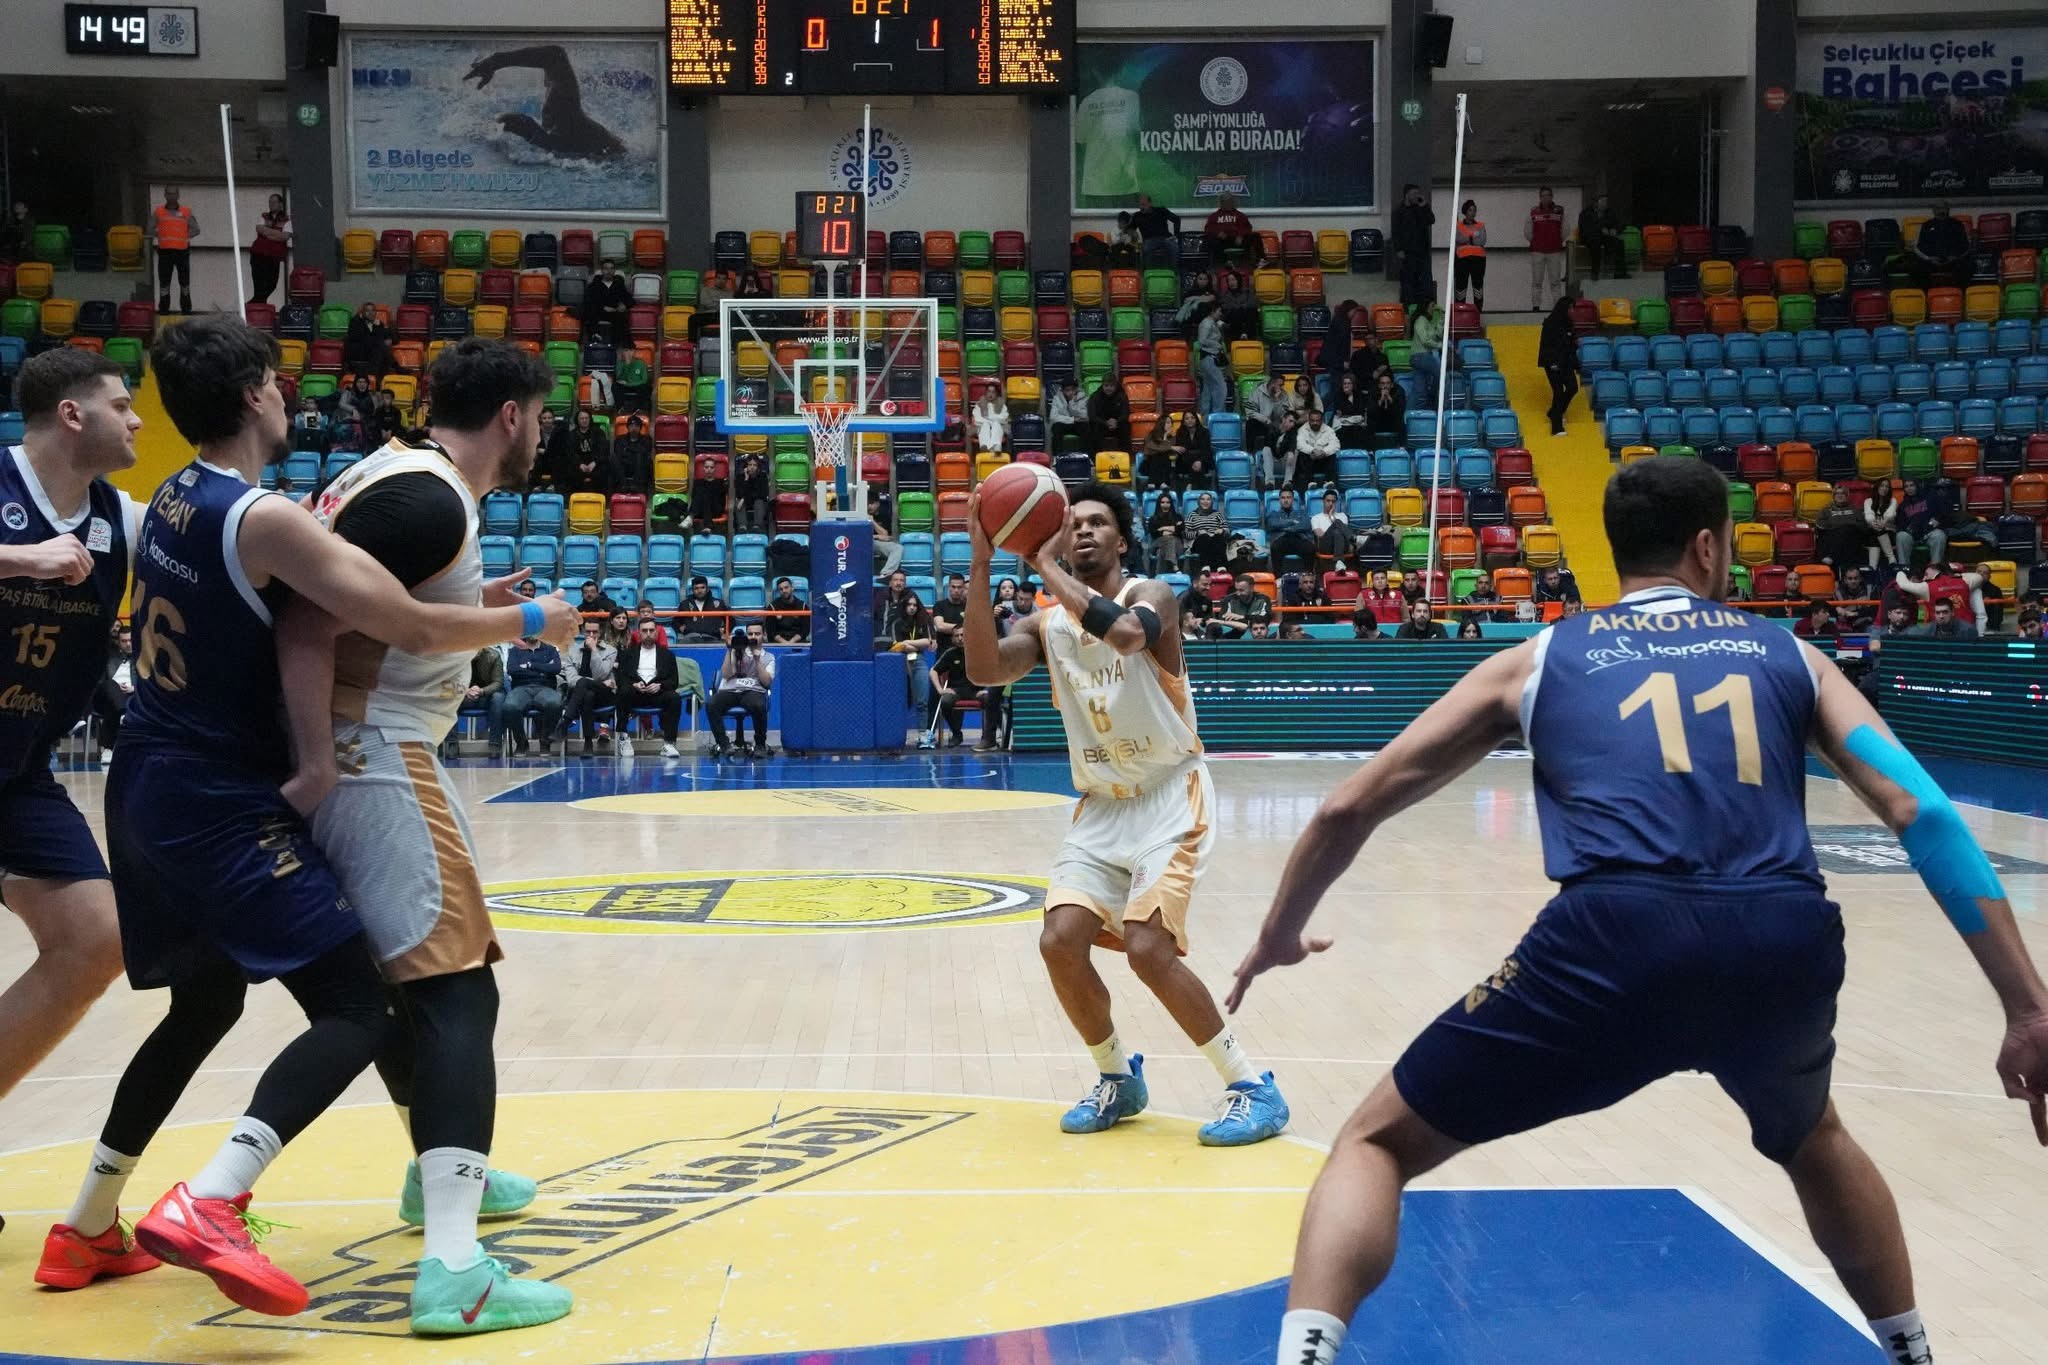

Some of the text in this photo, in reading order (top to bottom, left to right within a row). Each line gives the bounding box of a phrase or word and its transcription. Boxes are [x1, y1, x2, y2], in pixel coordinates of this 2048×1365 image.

[80, 16, 145, 43] 14 49
[807, 18, 825, 48] 0
[874, 18, 881, 44] 1
[931, 18, 939, 47] 1
[1823, 40, 1996, 65] Selçuklu Çiçek
[784, 72, 793, 85] 2
[1823, 56, 2024, 101] Bahçesi
[1174, 111, 1265, 129] ŞAMPİYONLUĞA
[1140, 131, 1301, 154] KOŞANLAR BURADA!
[367, 149, 473, 171] 2 Bölgede
[816, 196, 856, 214] 8 21
[823, 221, 850, 253] 10
[1588, 609, 1748, 635] AKKOYUN
[11, 623, 61, 668] 15
[1618, 672, 1762, 786] 11
[455, 1163, 484, 1180] 23
